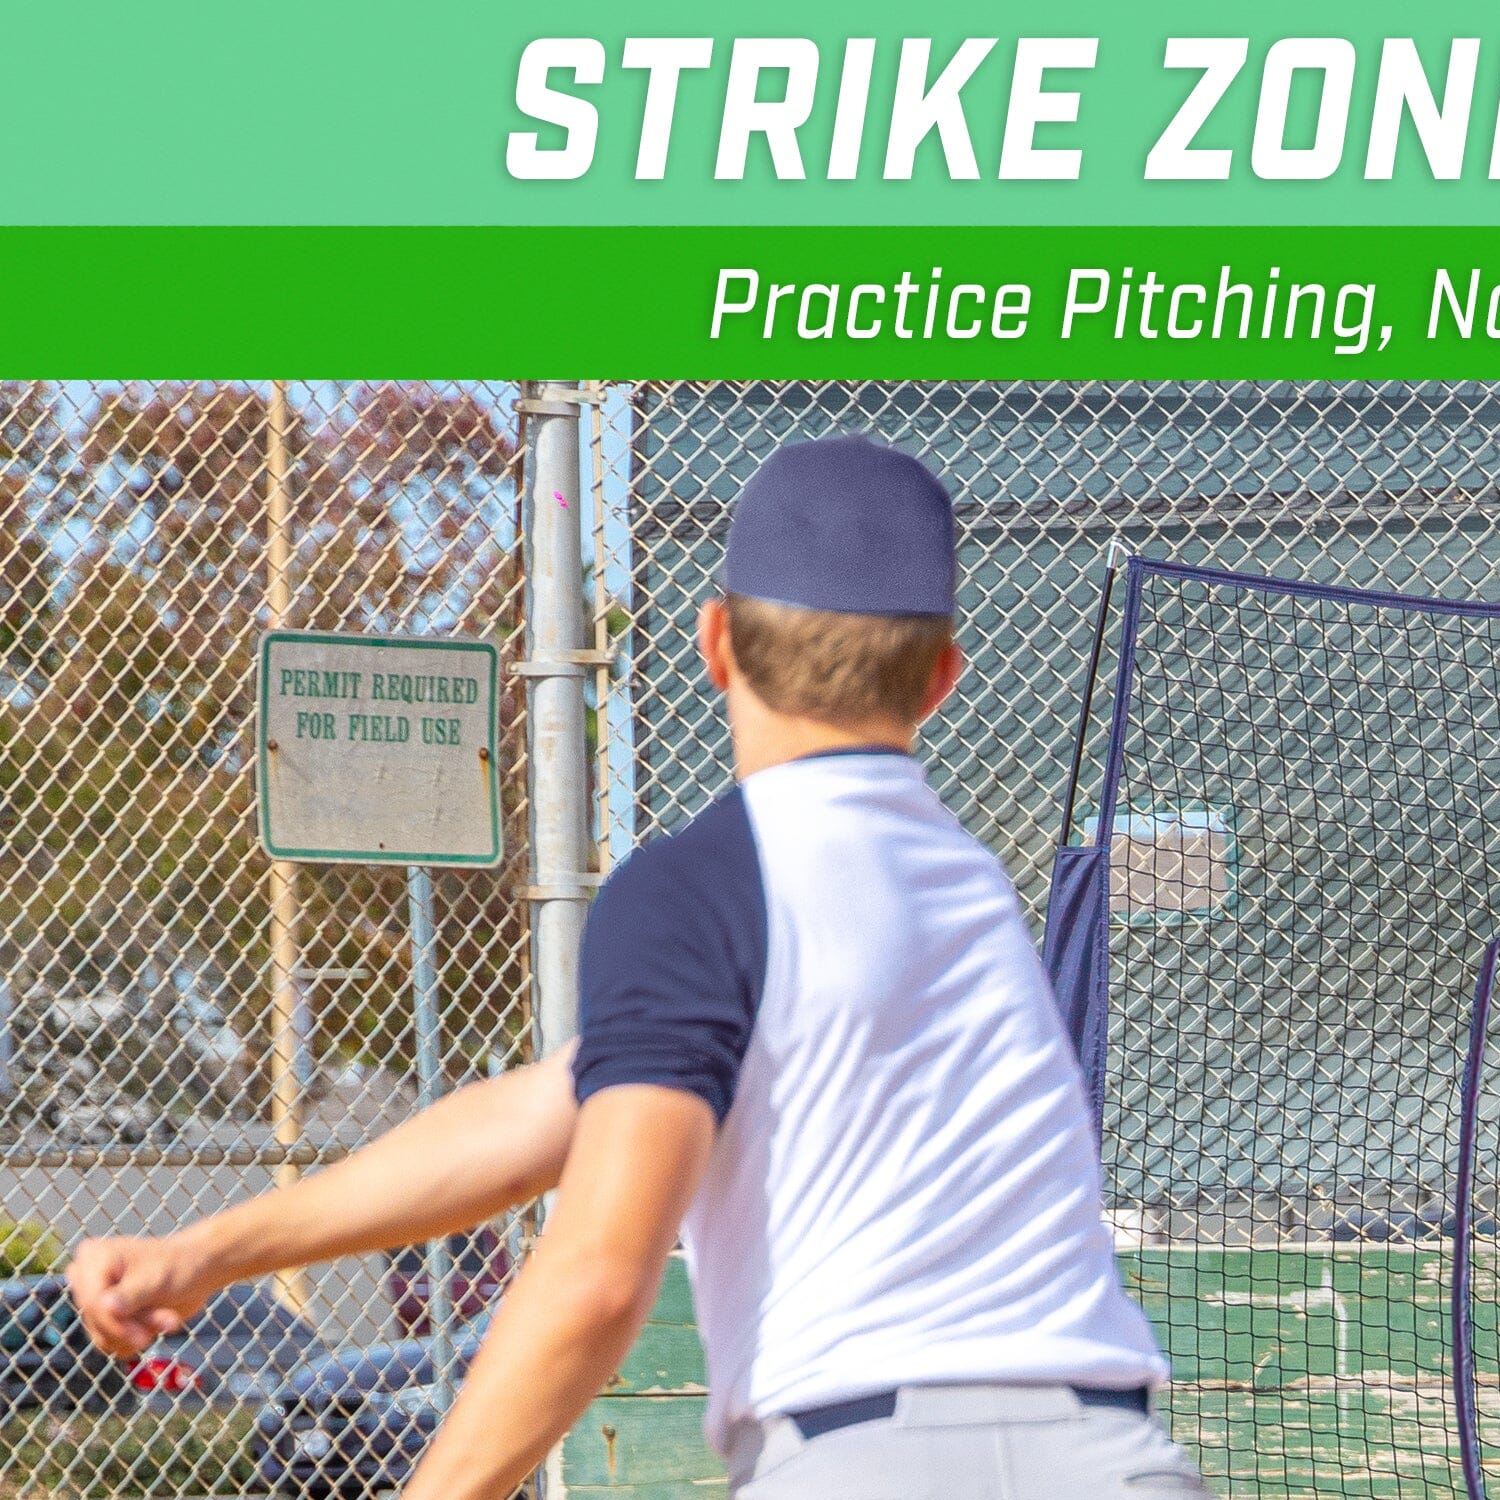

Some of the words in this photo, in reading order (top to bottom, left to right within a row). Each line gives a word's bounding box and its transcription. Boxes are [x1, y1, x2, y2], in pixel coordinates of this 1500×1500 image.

[280, 669, 362, 699] PERMIT
[372, 673, 478, 704] REQUIRED
[295, 711, 336, 740] FOR
[347, 714, 410, 743] FIELD
[421, 717, 461, 745] USE
